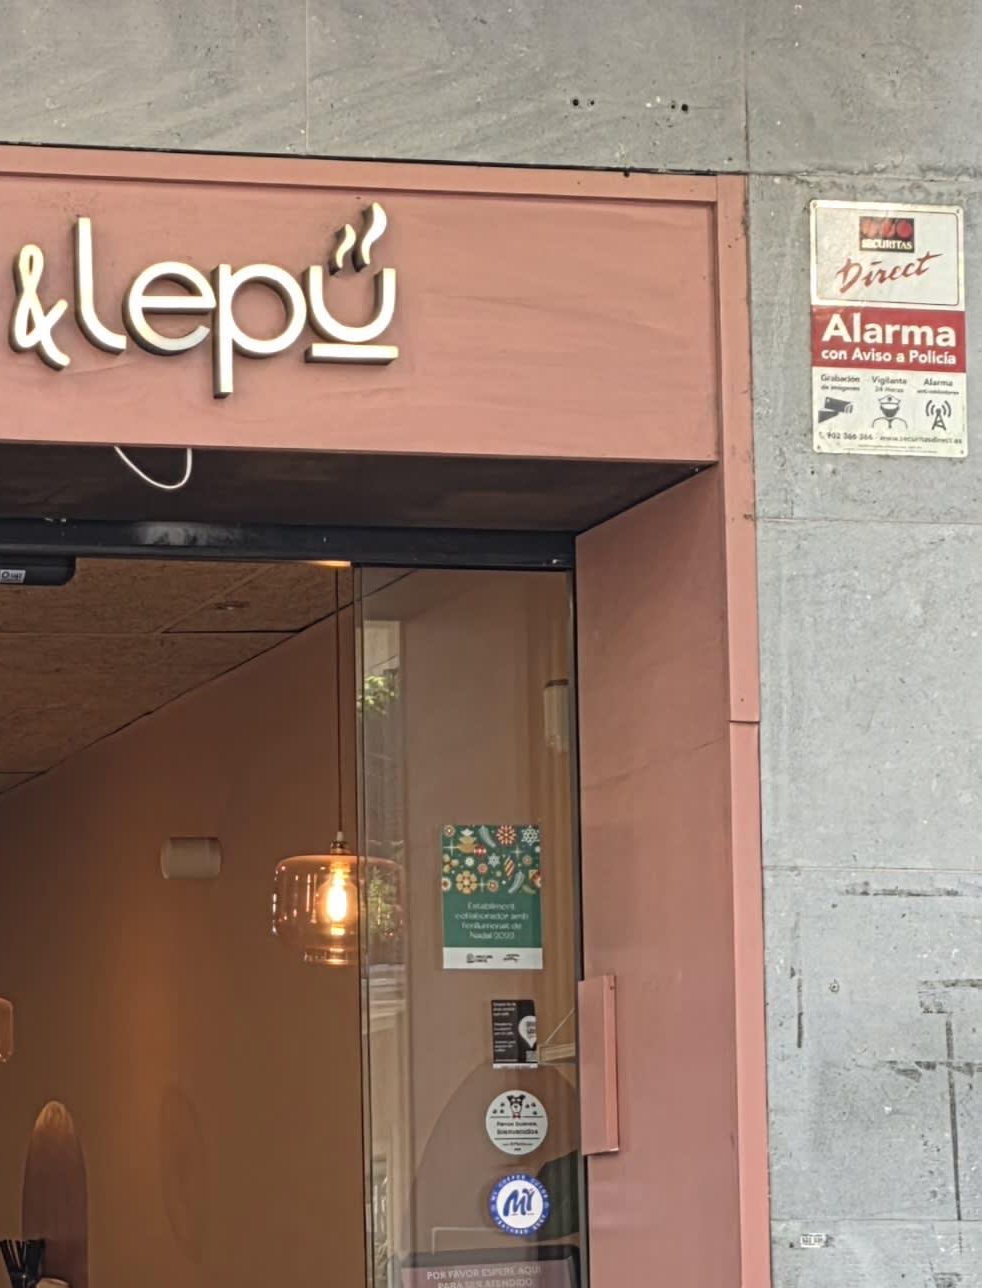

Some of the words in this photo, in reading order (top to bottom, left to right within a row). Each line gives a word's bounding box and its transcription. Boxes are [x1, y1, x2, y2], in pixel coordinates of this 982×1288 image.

[861, 238, 913, 250] SECURITAS
[836, 251, 944, 294] Direct
[821, 312, 957, 348] Alarma
[821, 349, 847, 361] con
[851, 347, 893, 363] Aviso
[896, 352, 906, 364] a
[908, 350, 957, 365] Policía
[871, 375, 907, 386] Vigilante
[923, 377, 954, 387] Alarma
[426, 1270, 446, 1281] POR
[448, 1269, 480, 1280] FAVOR
[481, 1267, 515, 1278] ESPERE
[483, 1278, 534, 1288] ATENDIDO
